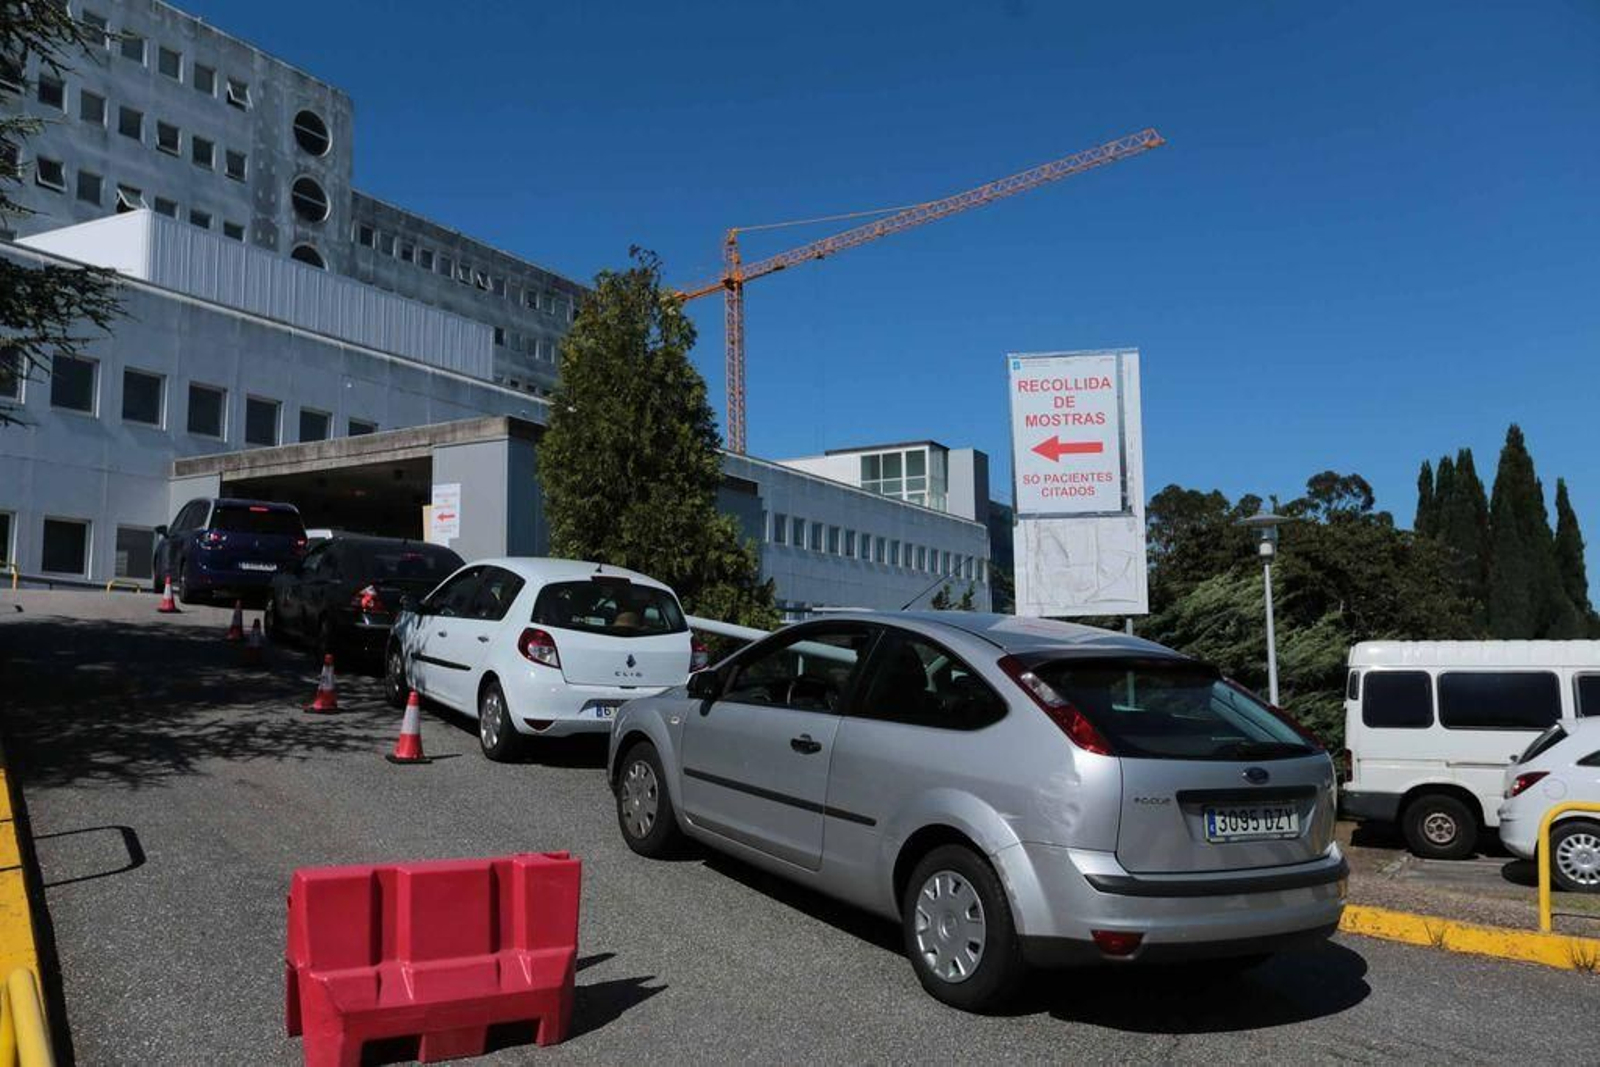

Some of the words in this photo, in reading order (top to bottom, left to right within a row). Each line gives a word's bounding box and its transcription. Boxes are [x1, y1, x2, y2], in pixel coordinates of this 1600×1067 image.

[1018, 377, 1112, 392] RECOLLIDA
[1054, 396, 1075, 409] DE
[1025, 412, 1106, 427] MOSTRAS
[1044, 472, 1113, 483] PACIENTES
[1041, 486, 1096, 498] CITADOS
[1218, 810, 1260, 832] 3095
[1264, 807, 1294, 831] DZY
